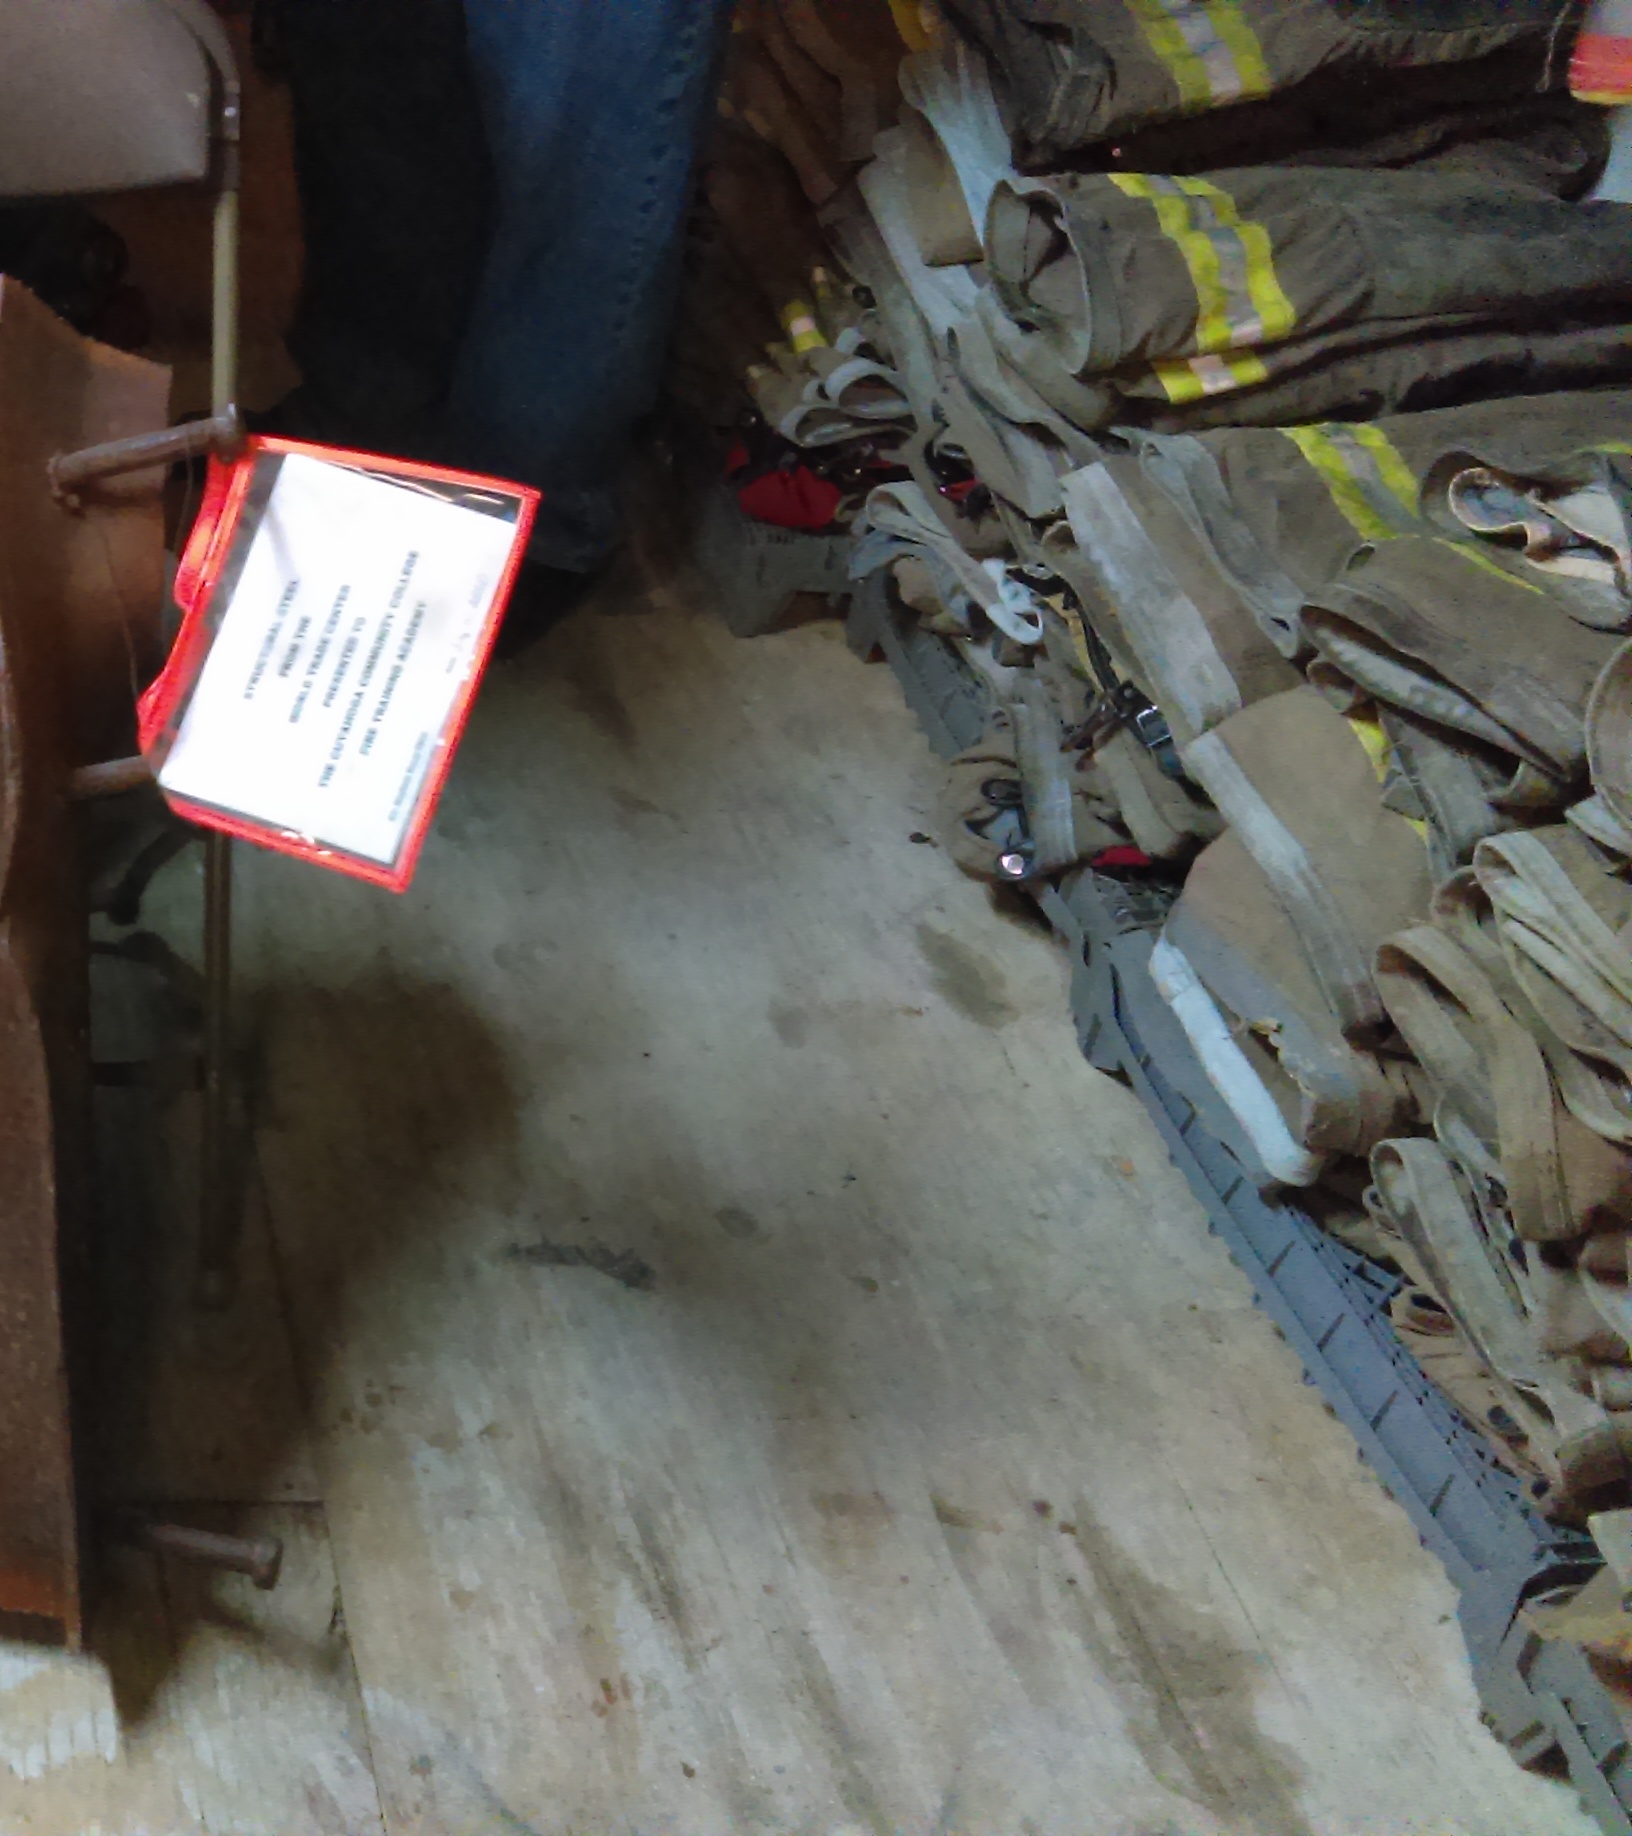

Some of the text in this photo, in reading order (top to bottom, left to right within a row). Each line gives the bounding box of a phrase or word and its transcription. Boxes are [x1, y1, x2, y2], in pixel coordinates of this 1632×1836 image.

[244, 579, 299, 698] STRUCTURAL STEEL
[278, 616, 310, 676] FROM THE
[289, 585, 349, 722] WORLD TRADE CENTER
[319, 764, 335, 786] THE
[359, 613, 393, 686] COMMUNITY
[390, 551, 418, 607] COLLEGE
[323, 617, 364, 706] PRESENTED TO
[359, 601, 426, 754] FIRE TRAINING ACADEMY
